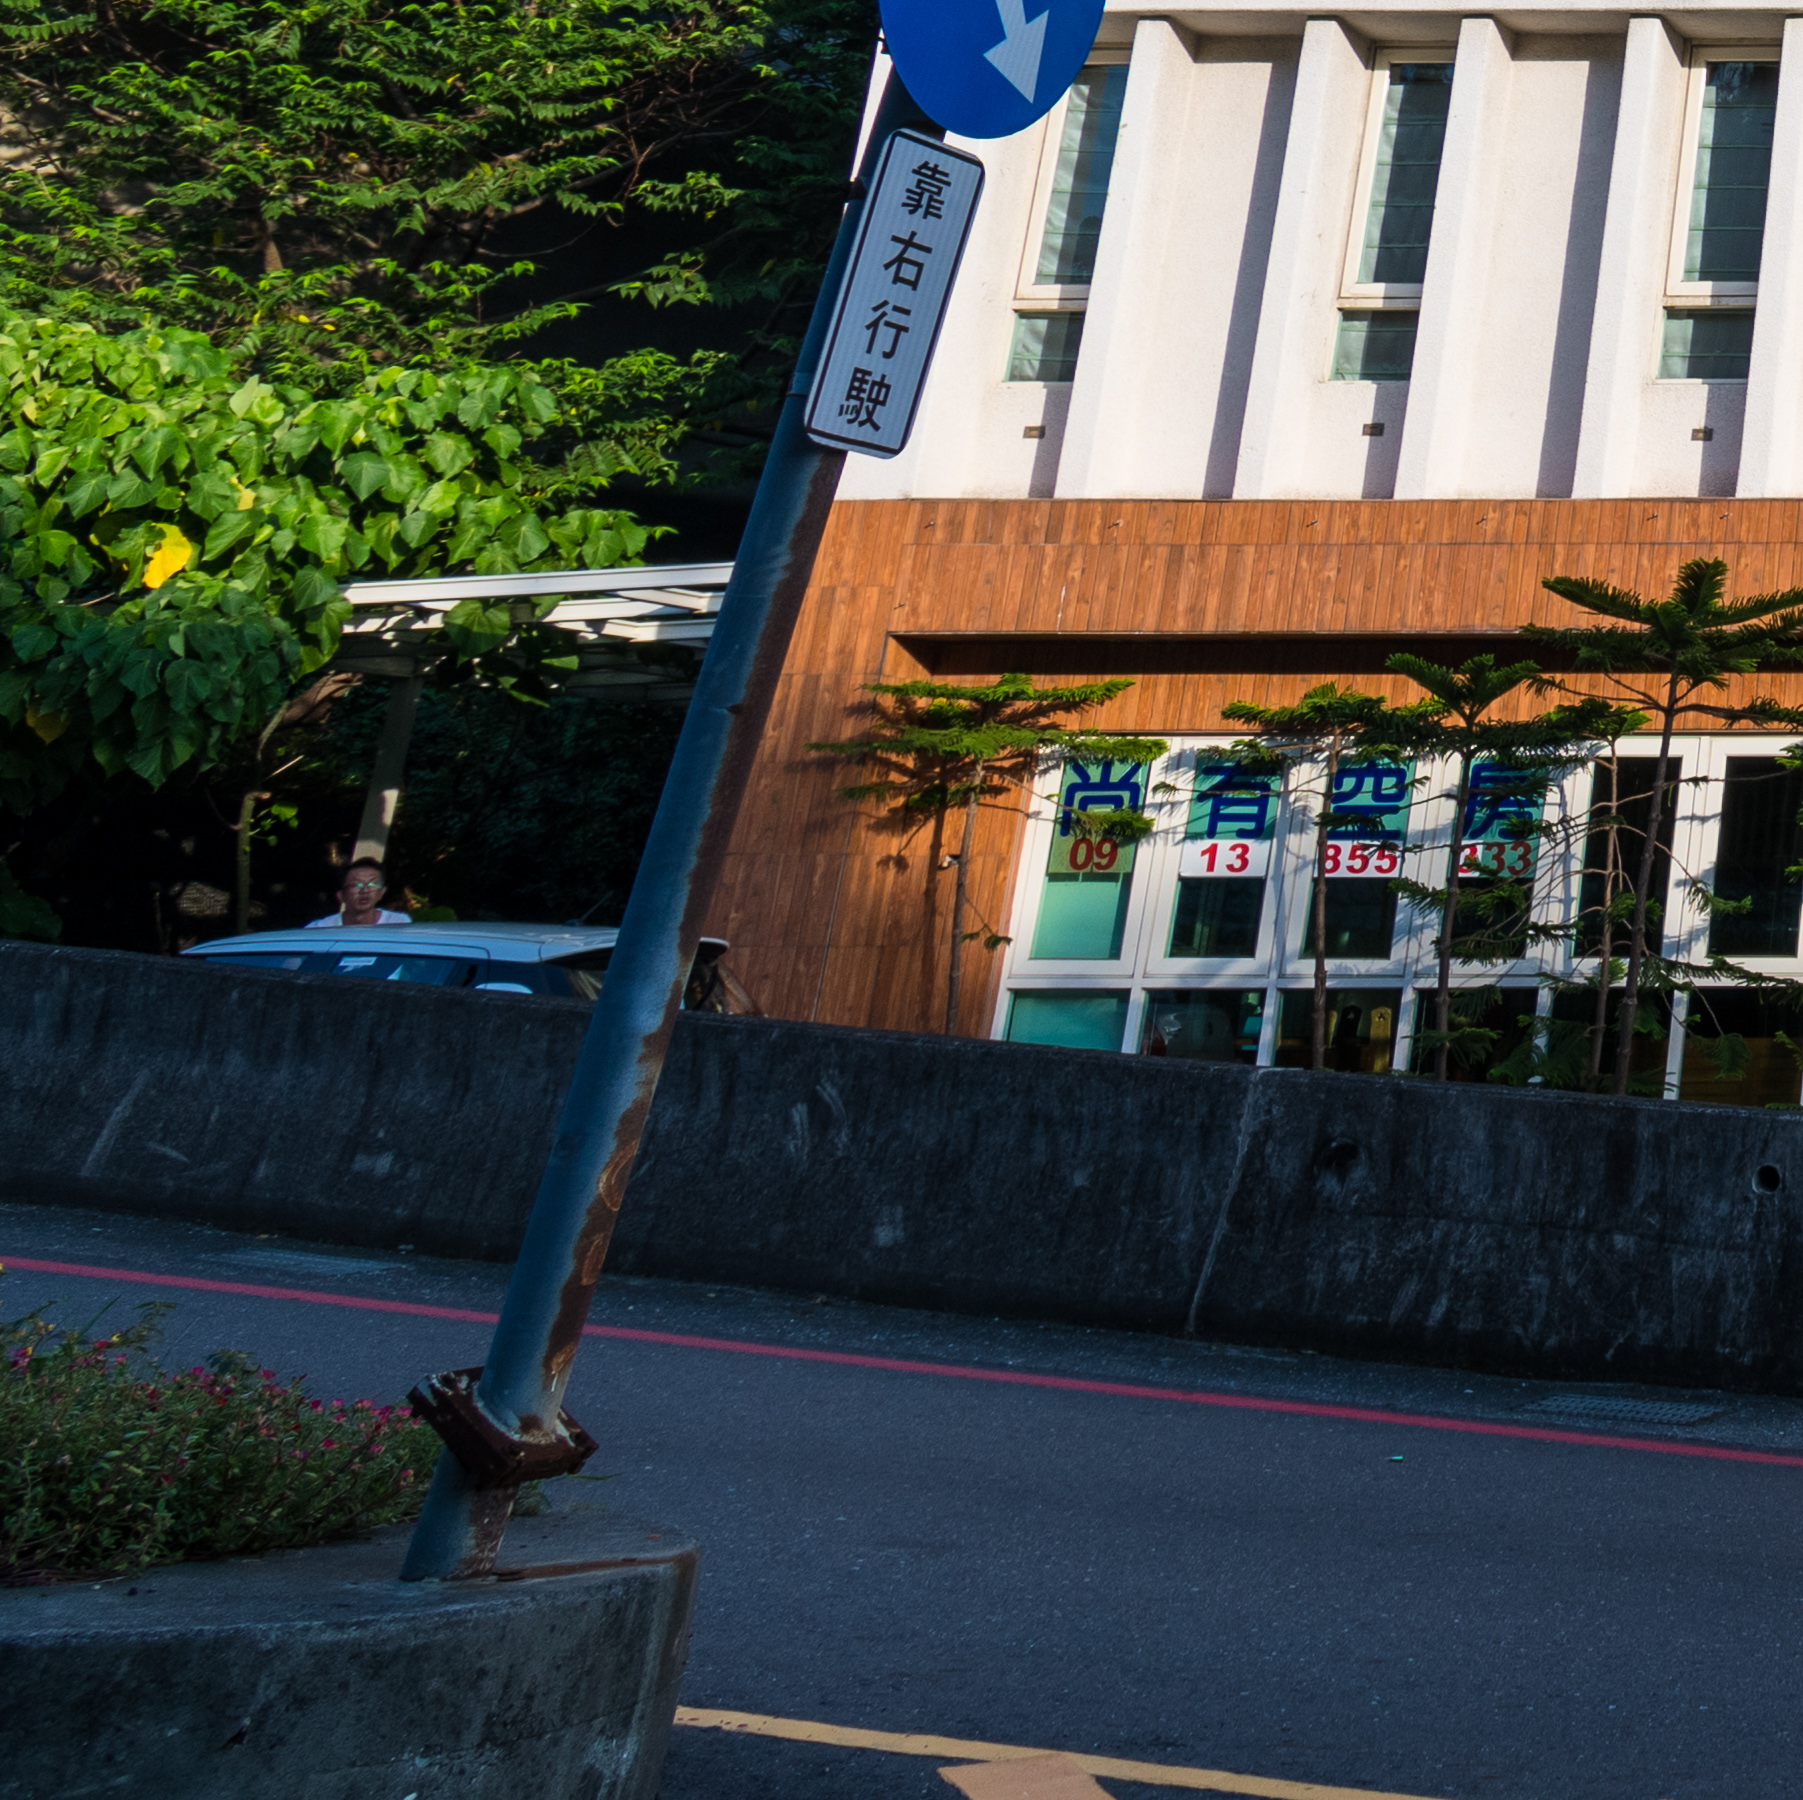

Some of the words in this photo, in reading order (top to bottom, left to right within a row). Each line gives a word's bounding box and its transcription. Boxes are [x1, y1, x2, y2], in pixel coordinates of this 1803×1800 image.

[837, 160, 953, 433] 靠右行駛
[1068, 837, 1119, 872] 09
[1199, 842, 1251, 874] 13
[1323, 843, 1399, 875] 855
